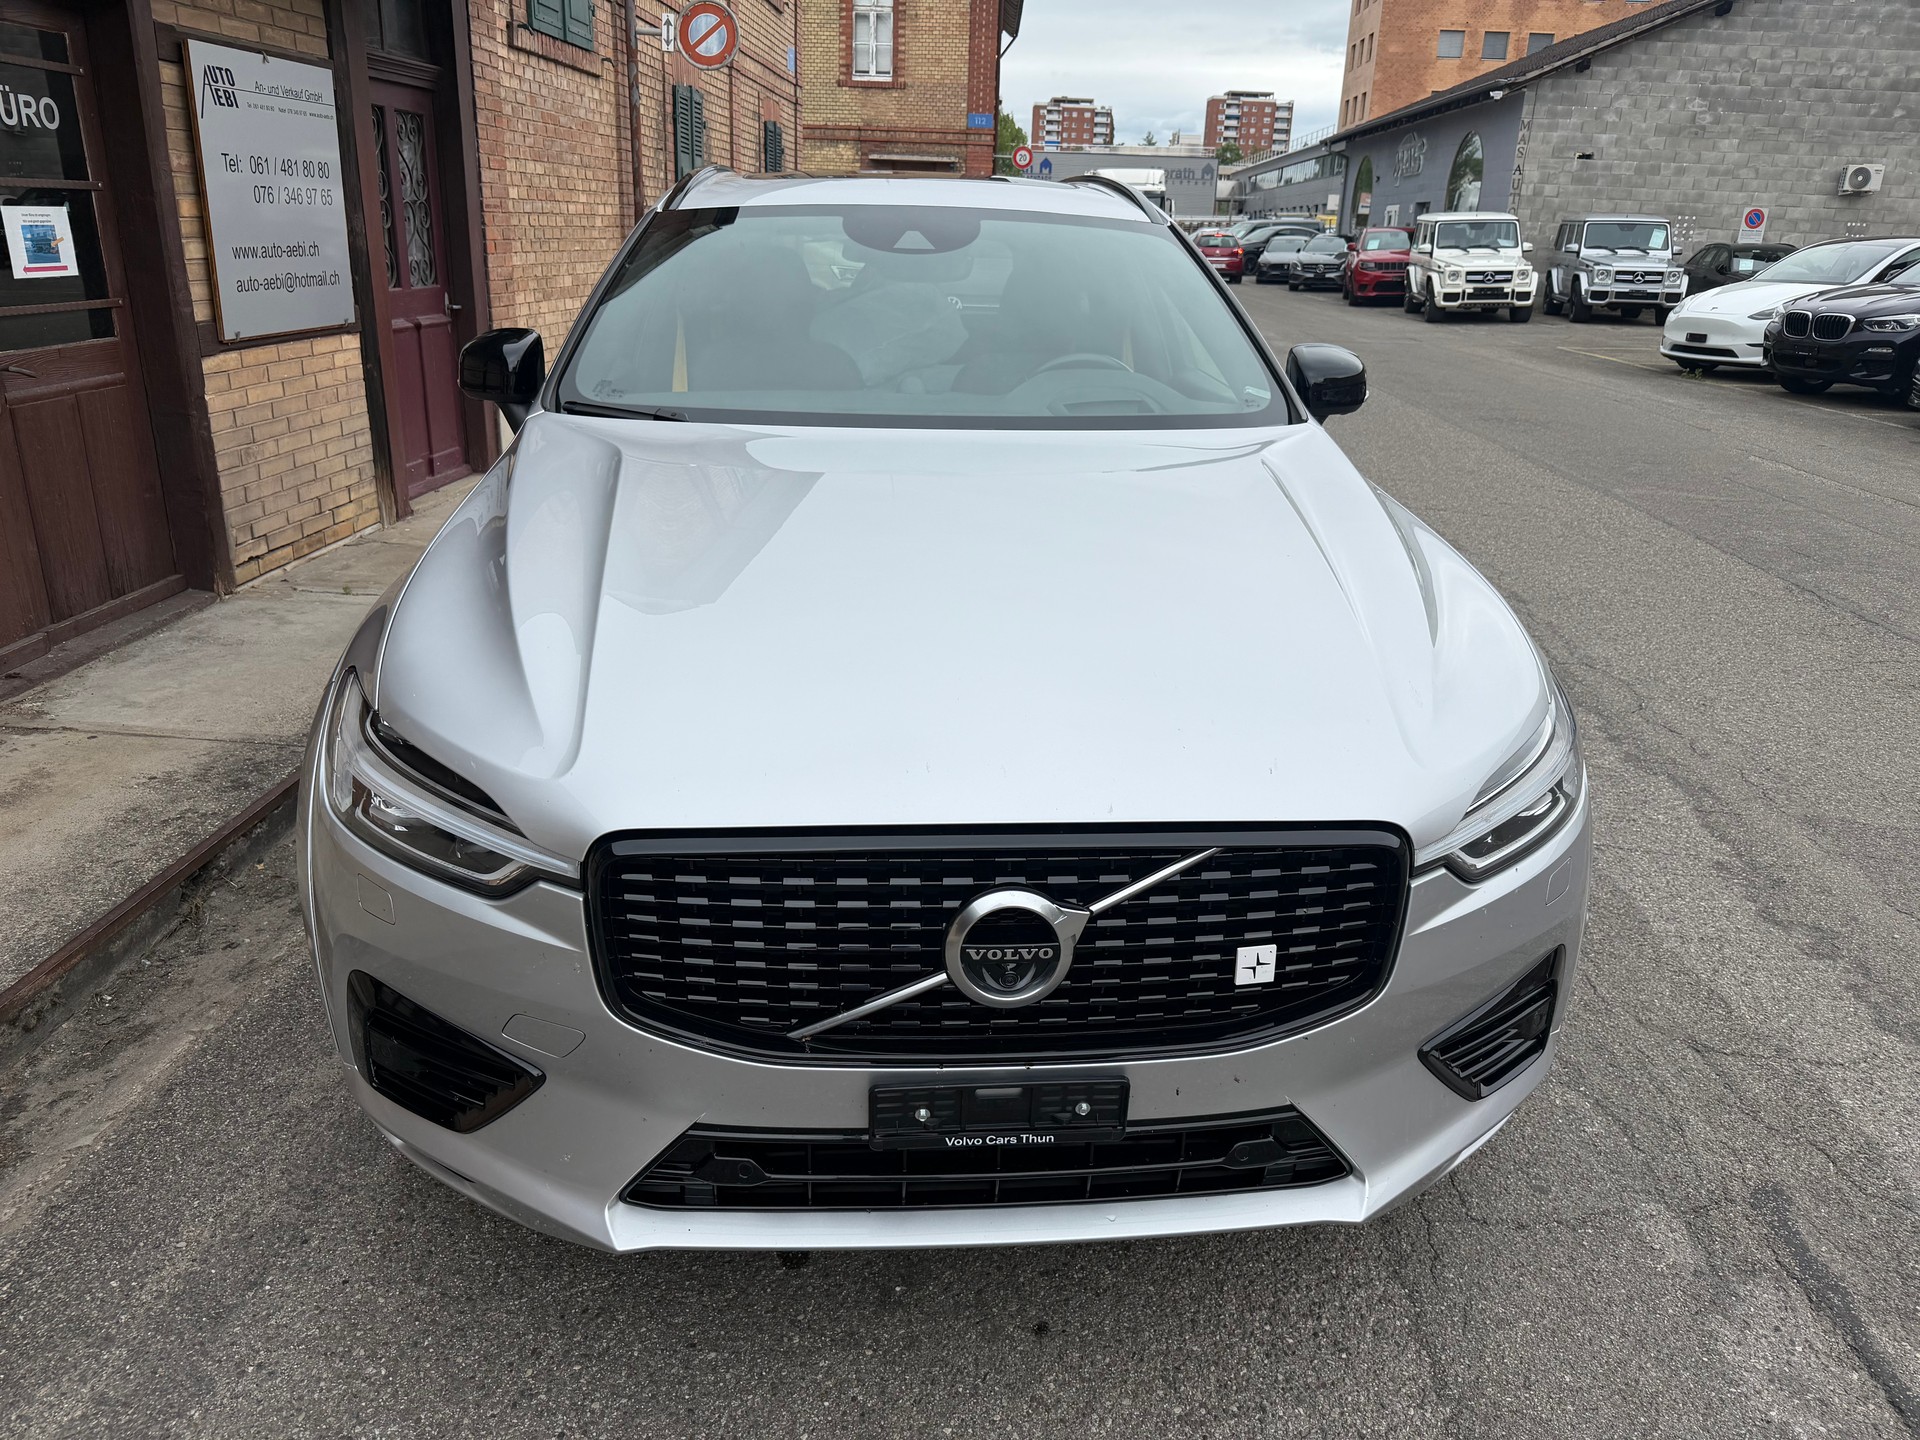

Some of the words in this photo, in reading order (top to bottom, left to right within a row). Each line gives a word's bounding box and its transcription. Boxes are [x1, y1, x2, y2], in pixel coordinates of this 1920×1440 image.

[255, 80, 266, 93] An-
[267, 84, 280, 96] und
[280, 84, 304, 99] Verkauf
[304, 89, 323, 102] GmbH
[974, 117, 986, 125] 112
[221, 152, 243, 174] Tel:
[249, 155, 270, 176] 061
[280, 158, 300, 177] 481
[302, 160, 316, 178] 80
[317, 161, 330, 179] 80
[1018, 153, 1028, 162] 20
[253, 185, 275, 205] 076
[283, 186, 304, 205] 346
[305, 188, 318, 206] 97
[320, 188, 333, 206] 65
[231, 241, 320, 260] www.auto-aebi.ch
[236, 270, 341, 293] auto-aebi@hotmail.ch
[965, 947, 1054, 961] VOLVO
[945, 1136, 983, 1147] Volvo
[985, 1134, 1018, 1145] Cars
[1020, 1133, 1055, 1144] Thun
